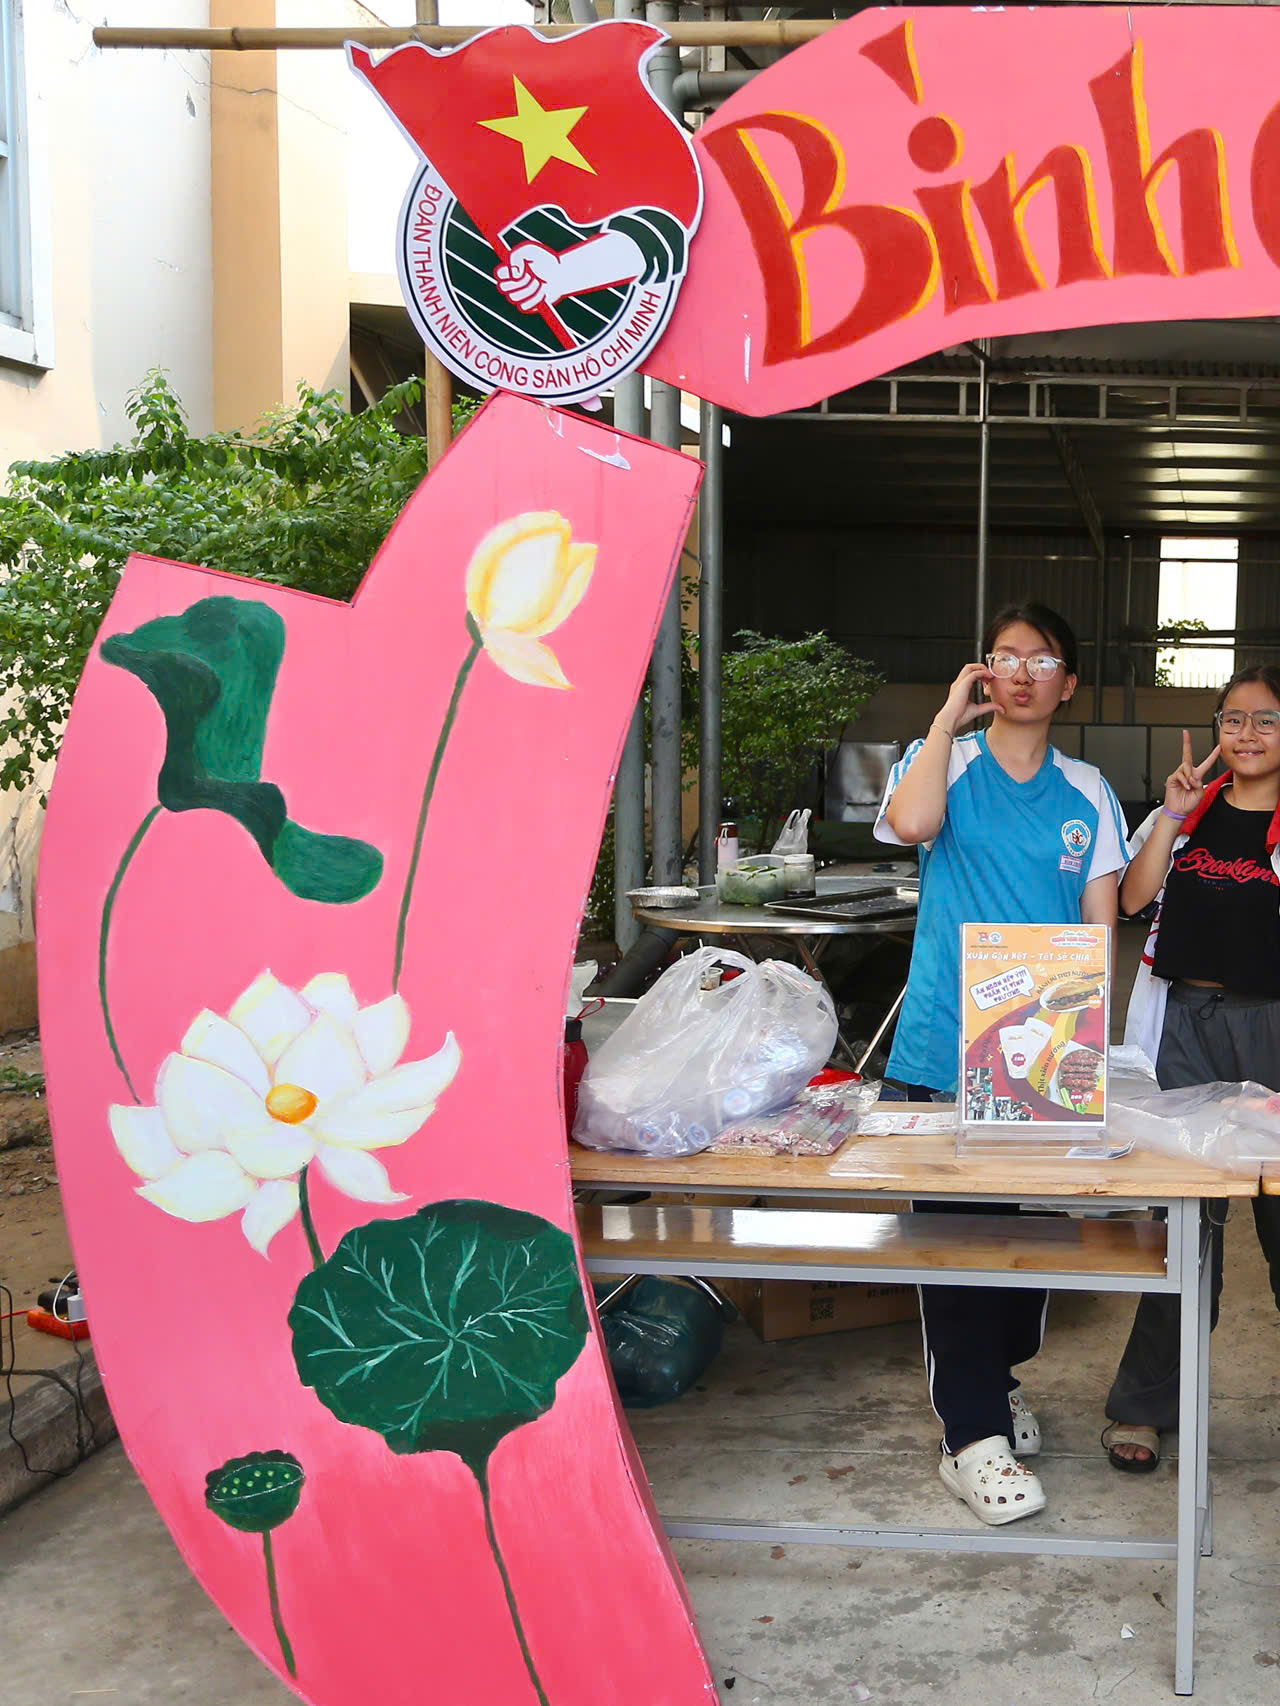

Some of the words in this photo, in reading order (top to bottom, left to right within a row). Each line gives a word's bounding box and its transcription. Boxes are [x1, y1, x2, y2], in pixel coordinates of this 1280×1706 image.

[413, 184, 443, 243] ĐOÀN
[413, 247, 447, 317] THANH
[624, 290, 661, 342] MINH
[435, 314, 477, 359] NIÊN
[600, 331, 633, 367] CHÍ
[474, 350, 529, 387] CỘNG
[533, 363, 572, 389] SẢN
[572, 352, 601, 383] HỒ
[1176, 848, 1274, 883] Brooklyn
